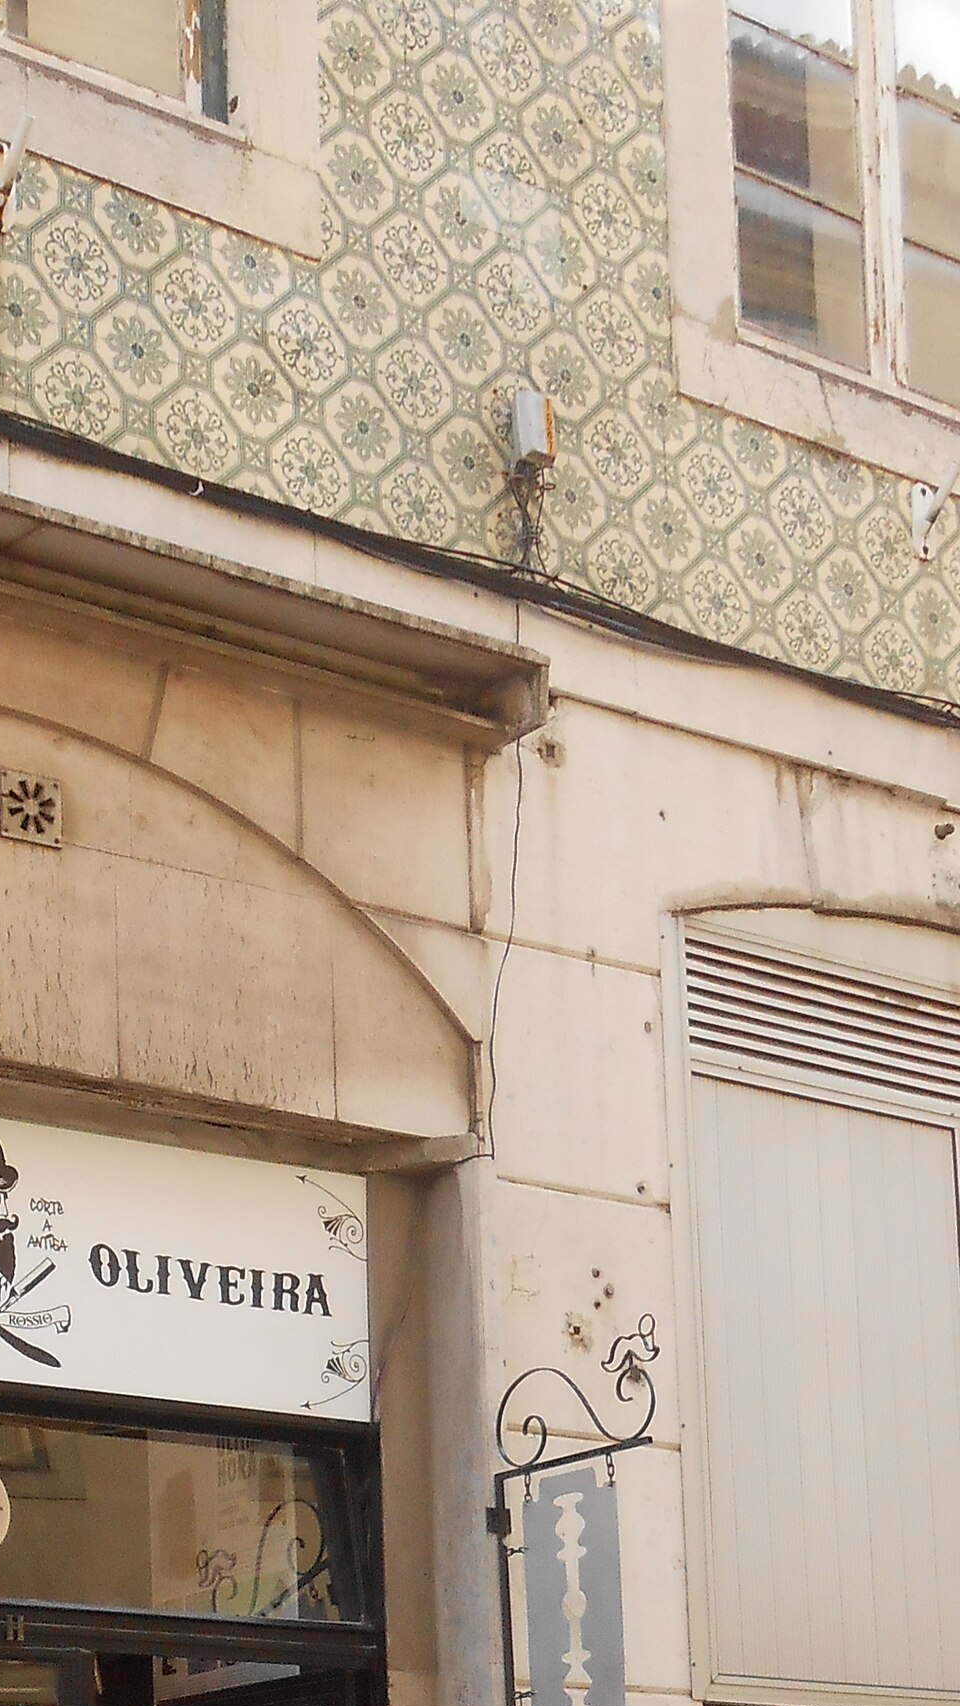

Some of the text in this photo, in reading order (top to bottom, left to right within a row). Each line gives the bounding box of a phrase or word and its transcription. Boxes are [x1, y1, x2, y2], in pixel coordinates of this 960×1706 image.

[29, 1198, 65, 1215] CORTE
[42, 1219, 53, 1232] A
[88, 1243, 333, 1317] OLIVEIRA
[8, 1313, 53, 1326] ROSSIO
